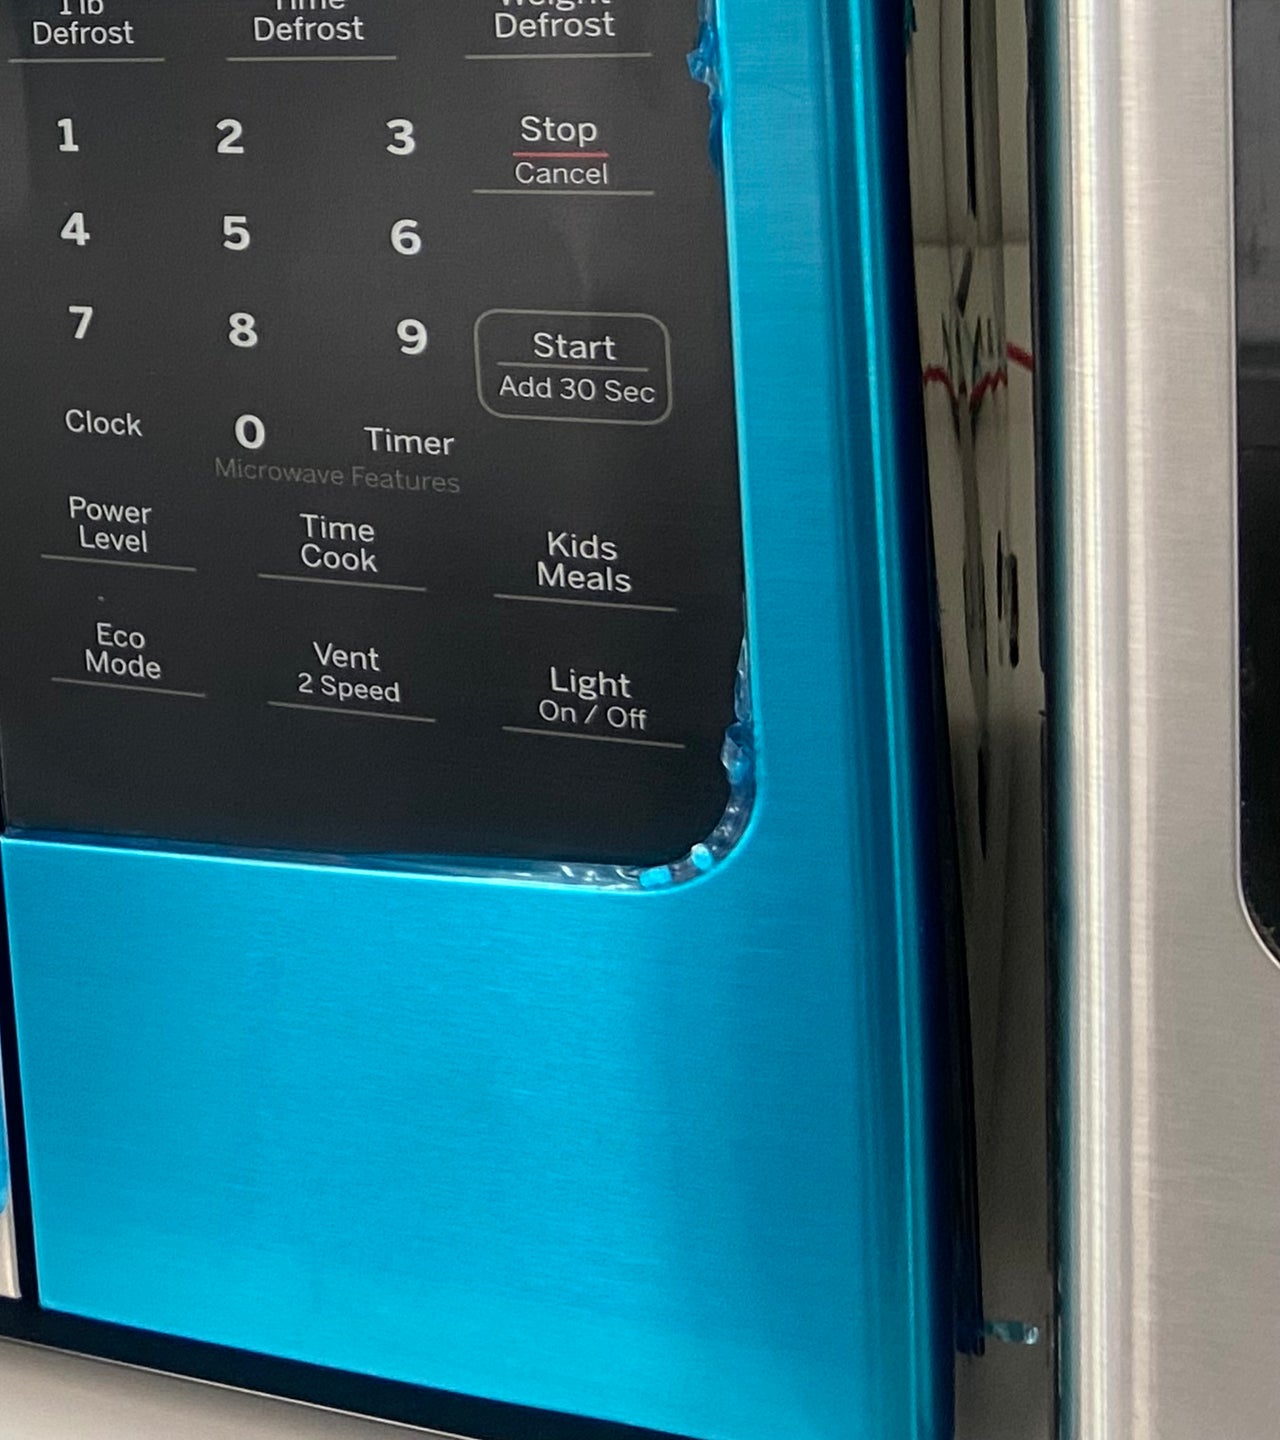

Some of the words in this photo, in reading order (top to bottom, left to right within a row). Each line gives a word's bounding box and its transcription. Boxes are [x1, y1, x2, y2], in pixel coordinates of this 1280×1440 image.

[34, 21, 134, 44] Defrost
[255, 16, 364, 40] Defrost
[496, 12, 615, 37] Defrost
[58, 119, 79, 151] 1
[217, 119, 244, 153] 2
[387, 119, 415, 155] 3
[522, 116, 597, 147] Stop
[516, 162, 607, 184] Cancel
[61, 213, 90, 245] 4
[224, 216, 250, 250] 5
[392, 220, 421, 255] 6
[69, 306, 93, 339] 7
[229, 313, 257, 347] 8
[398, 319, 427, 354] 9
[534, 333, 616, 360] Start
[500, 376, 551, 398] Add
[561, 378, 595, 400] 30
[605, 380, 655, 403] Sec
[66, 409, 142, 436] Clock
[236, 415, 265, 449] 0
[364, 427, 454, 454] Timer
[216, 457, 344, 485] Microwave
[351, 466, 460, 493] Features
[70, 496, 151, 524] Power
[80, 526, 147, 552] Level
[300, 514, 374, 542] Time
[302, 544, 377, 572] Cook
[548, 532, 617, 560] Kids
[538, 562, 631, 592] Meals
[97, 623, 145, 648] Eco
[86, 649, 160, 679] Mode
[313, 642, 379, 671] Vent
[299, 673, 313, 693] 2
[321, 675, 400, 702] Speed
[550, 667, 631, 701] Light
[540, 700, 576, 722] On
[607, 707, 646, 729] Off
